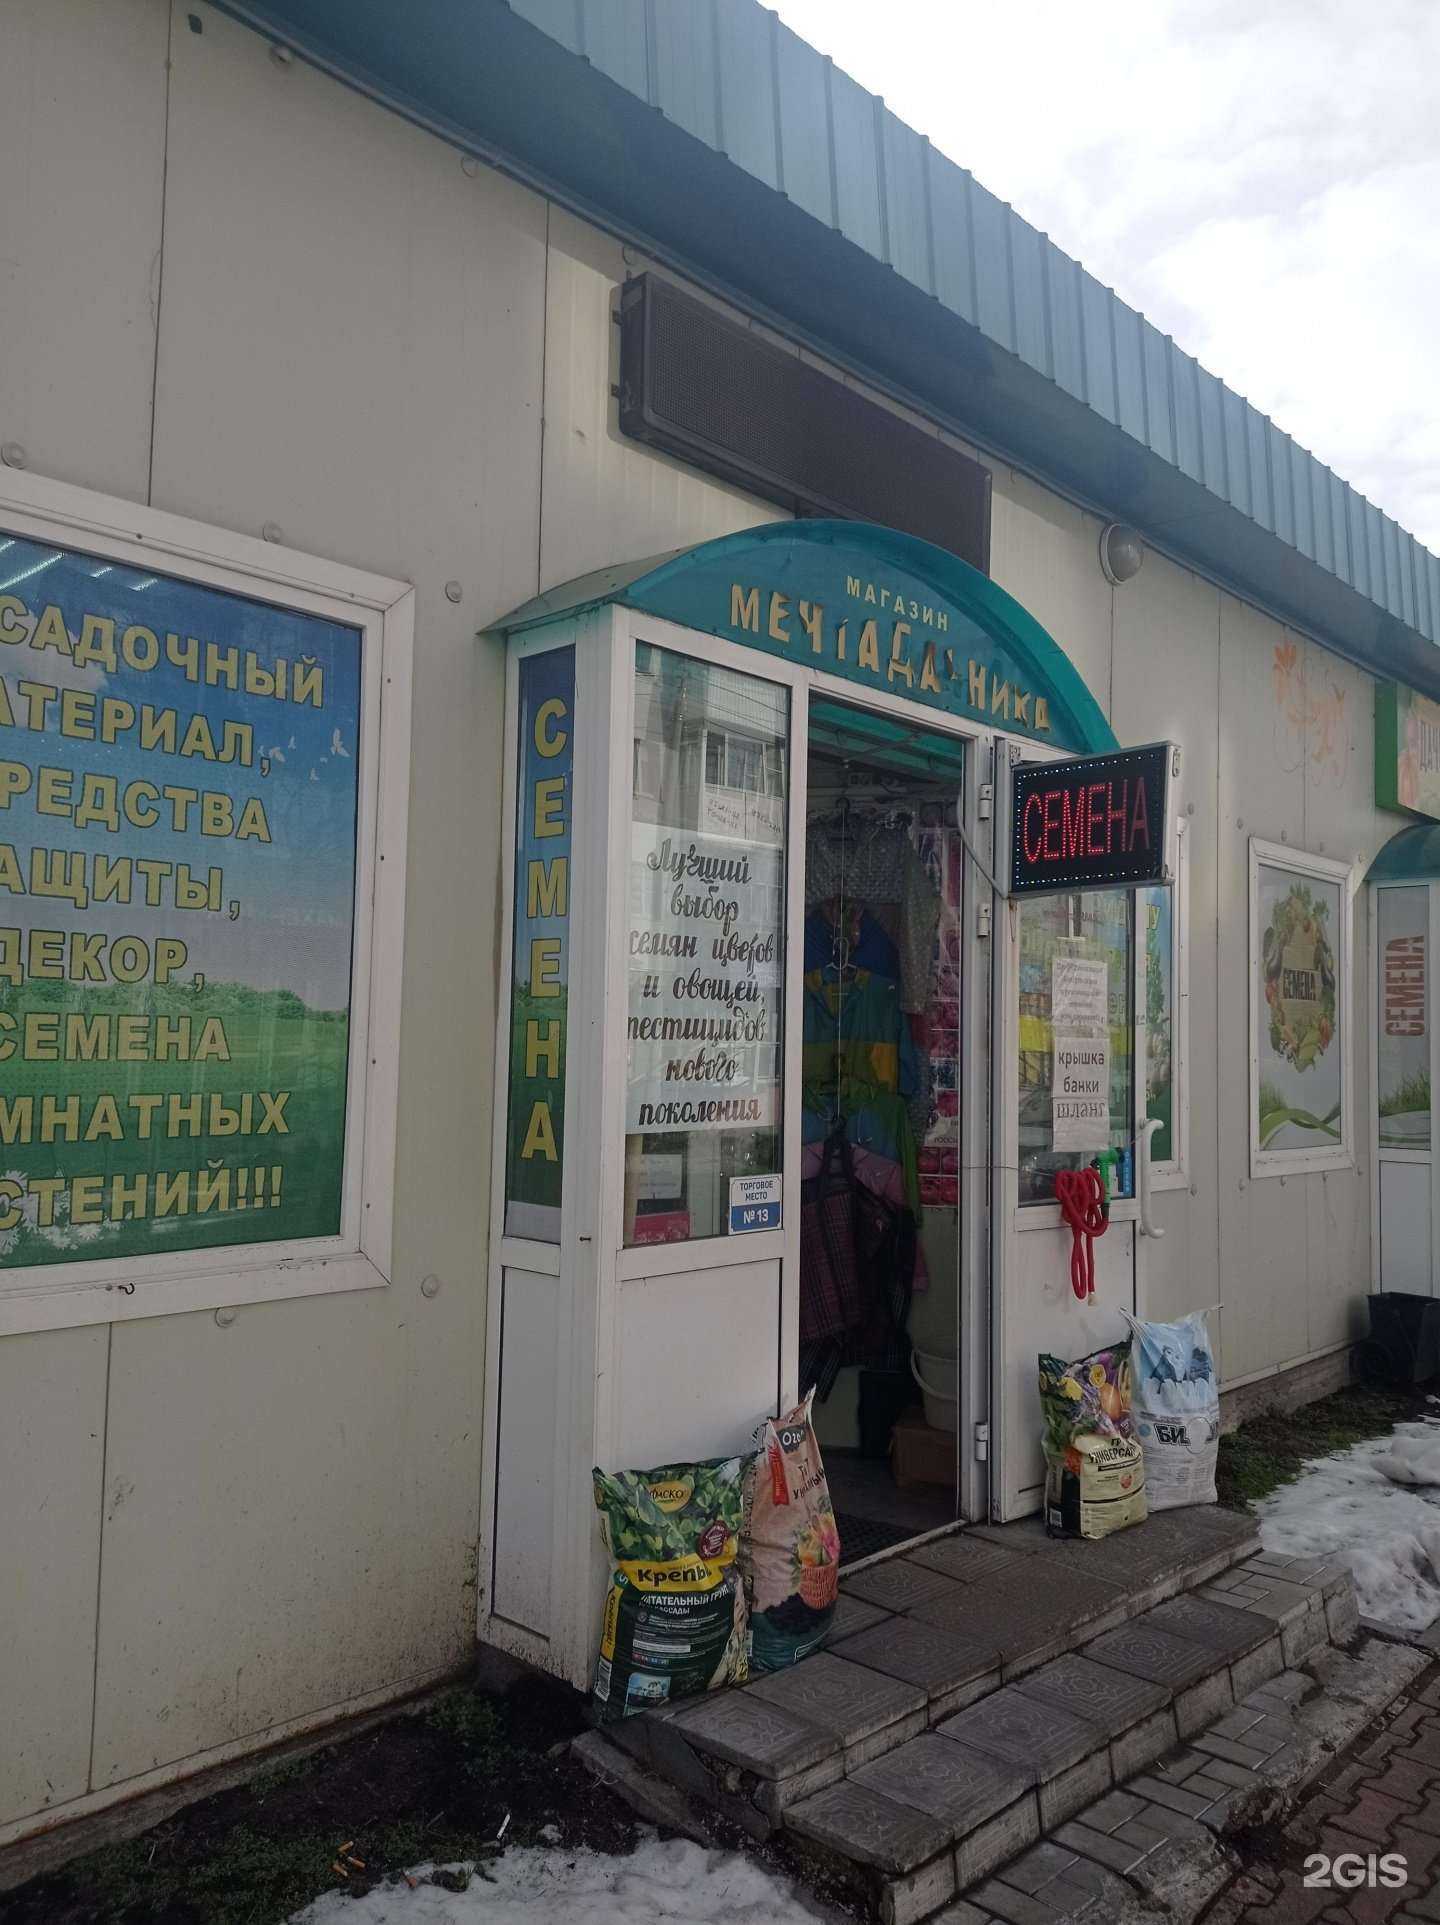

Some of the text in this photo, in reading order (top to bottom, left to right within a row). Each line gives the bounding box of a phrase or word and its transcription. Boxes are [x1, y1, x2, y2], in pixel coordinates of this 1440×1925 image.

[846, 575, 949, 632] МАГАЗИН
[0, 759, 272, 843] РЕДСТВА
[1023, 776, 1150, 864] СЕМЕНА
[646, 838, 752, 884] Лучший
[521, 698, 568, 1162] СЕМЕНА
[671, 883, 739, 936] выбор
[0, 927, 206, 994] ДЕКОР,
[629, 930, 774, 977] семян цветов
[643, 975, 660, 998] и
[1385, 935, 1425, 1037] СЕМЕНА
[0, 1010, 231, 1062] СЕМЕНА
[628, 1005, 767, 1047] пестицидов
[665, 1048, 738, 1082] нового
[1058, 1051, 1105, 1069] крышка
[1063, 1076, 1099, 1093] банки
[638, 1098, 762, 1126] поколения
[740, 1181, 774, 1191] ТОРГОВОЕ
[745, 1191, 768, 1201] МЕСТО
